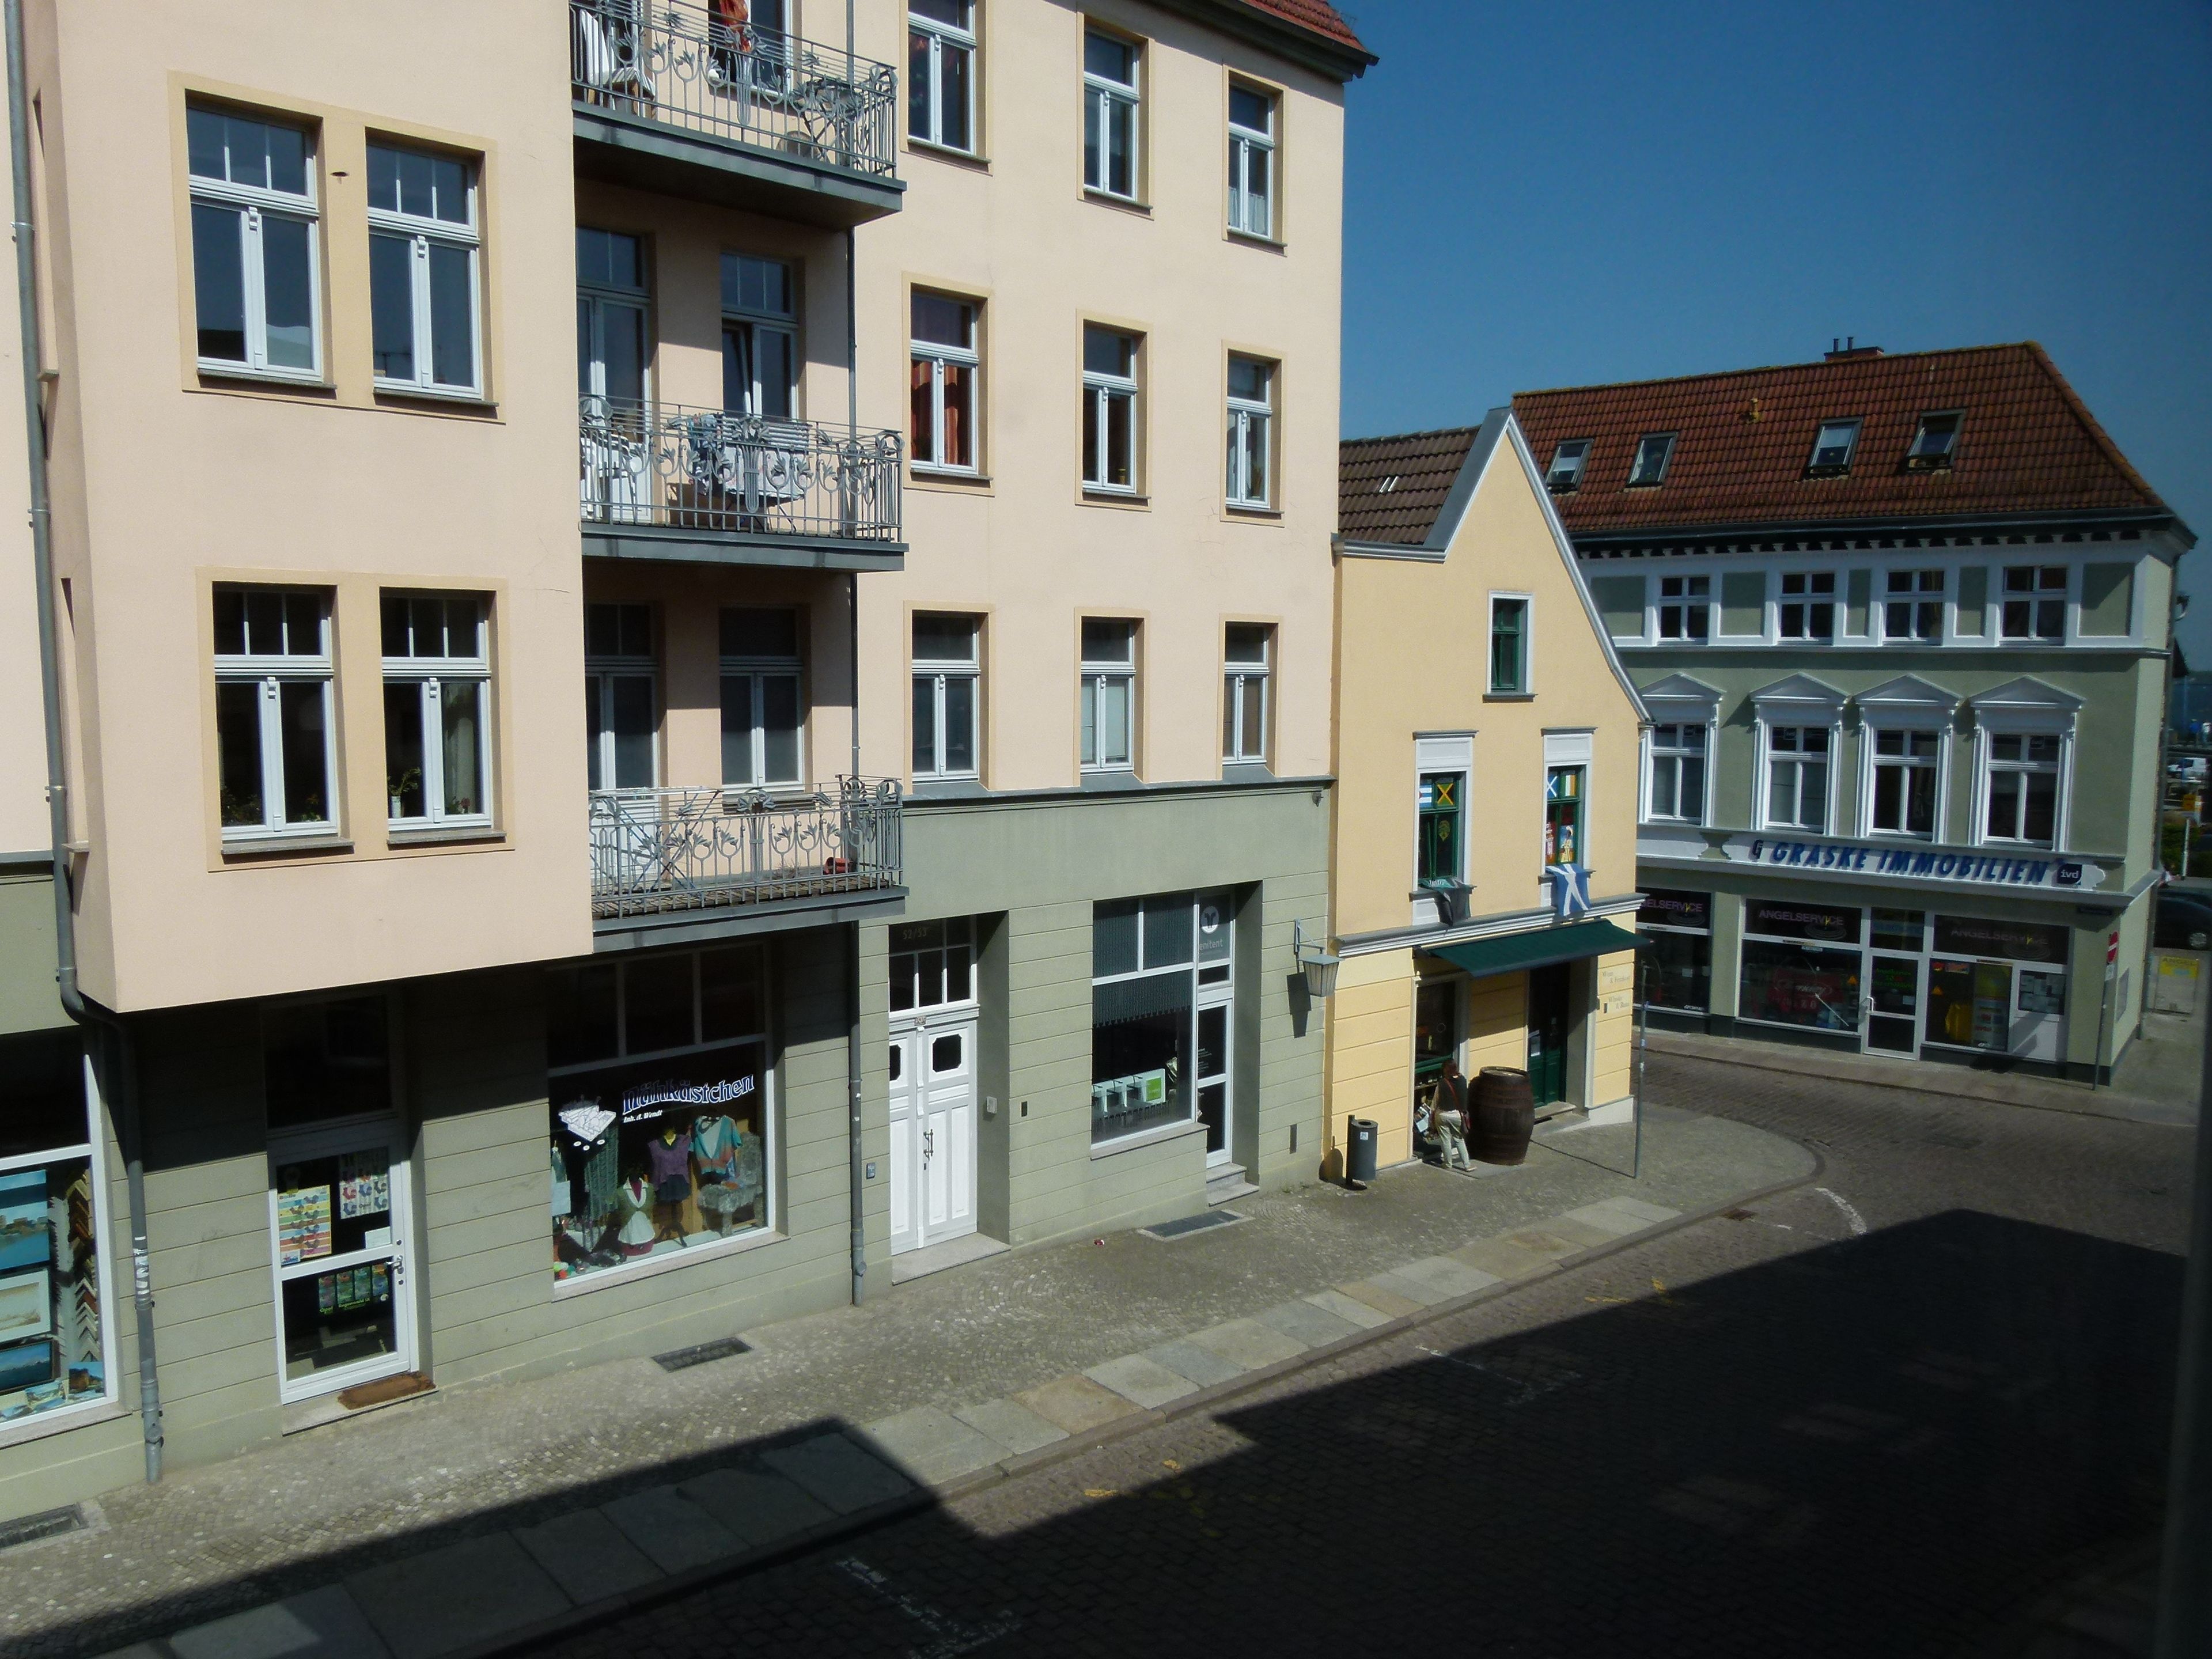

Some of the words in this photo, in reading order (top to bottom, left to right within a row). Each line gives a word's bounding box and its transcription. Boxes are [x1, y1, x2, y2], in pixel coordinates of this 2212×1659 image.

[1772, 842, 1870, 868] GRASKE
[1879, 849, 2050, 882] IMMOBILIEN
[2060, 869, 2080, 879] ivd
[1759, 909, 1844, 926] ANGELSERVICE
[622, 1074, 755, 1115] Nähkästchen
[643, 1109, 663, 1119] Wendt
